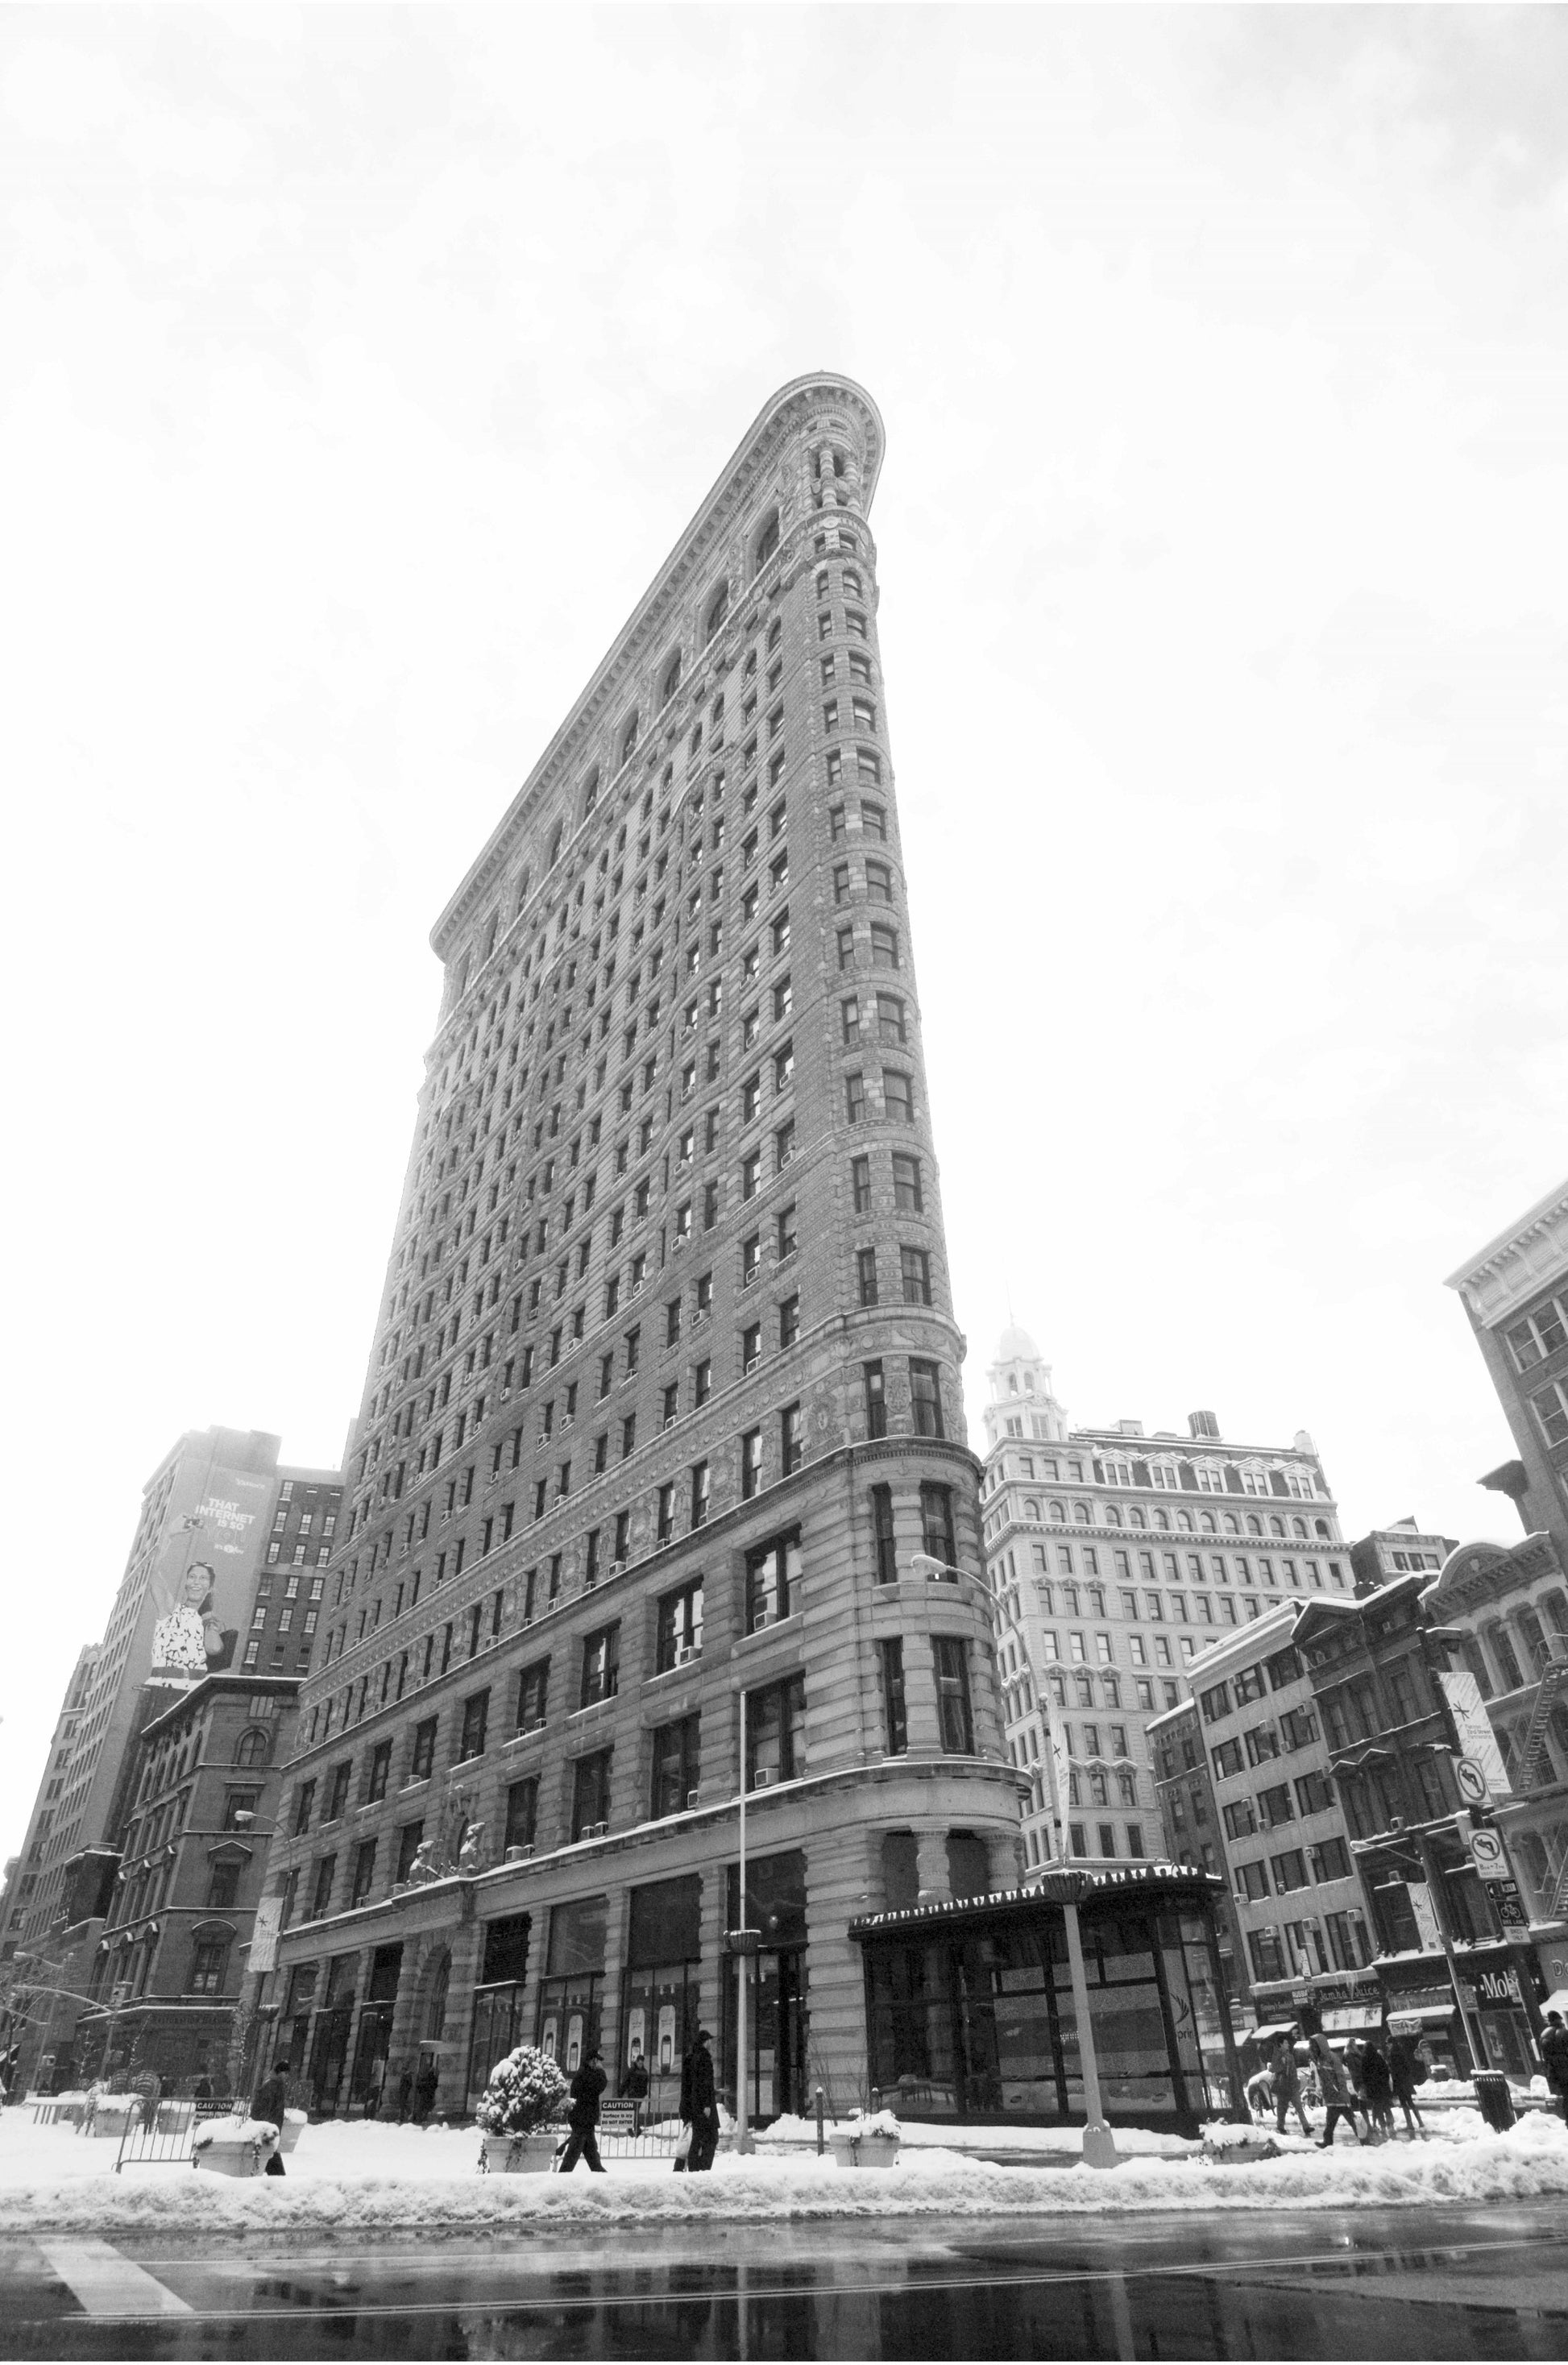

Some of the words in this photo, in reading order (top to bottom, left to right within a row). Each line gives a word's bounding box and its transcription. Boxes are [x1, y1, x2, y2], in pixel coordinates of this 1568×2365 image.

[209, 1498, 240, 1512] THAT
[194, 1504, 256, 1525] INTERNET
[218, 1518, 227, 1527] IS
[229, 1521, 245, 1530] SO
[1177, 2027, 1194, 2043] prin
